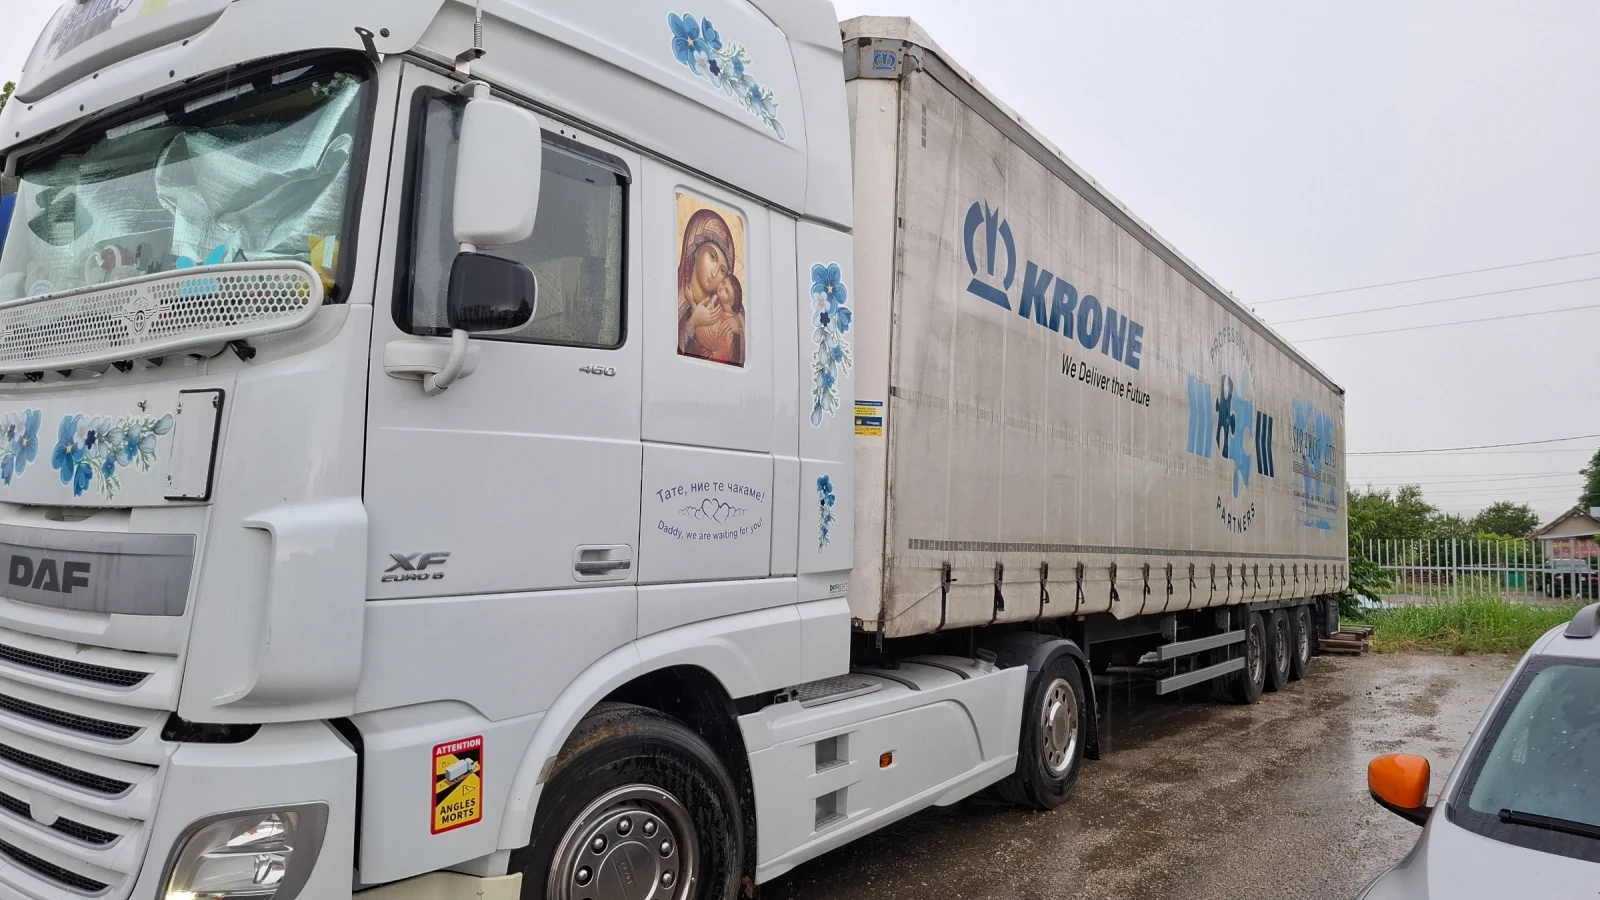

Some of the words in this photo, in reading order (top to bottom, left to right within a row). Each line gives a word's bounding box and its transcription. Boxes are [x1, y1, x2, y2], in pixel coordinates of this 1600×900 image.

[1018, 260, 1144, 371] KRONE
[578, 365, 617, 377] 460
[1062, 353, 1077, 378] We
[1079, 361, 1110, 391] Deliver
[1111, 376, 1125, 397] the
[1126, 382, 1150, 407] Future
[656, 485, 688, 503] Тате,
[690, 481, 710, 493] ние
[712, 482, 725, 492] те
[727, 482, 765, 503] чакаме!
[1216, 495, 1256, 534] PARTNERS
[657, 520, 684, 540] Daddy,
[686, 531, 697, 540] we
[699, 531, 711, 540] are
[712, 530, 738, 540] waiting
[739, 525, 749, 536] for
[749, 517, 764, 534] you!
[383, 551, 451, 573] XF
[8, 554, 92, 594] DAF
[381, 573, 431, 583] EURO
[432, 571, 445, 580] 6
[436, 738, 481, 756] ATTENTION
[440, 797, 476, 815] ANGLES
[441, 807, 475, 825] MORTS
